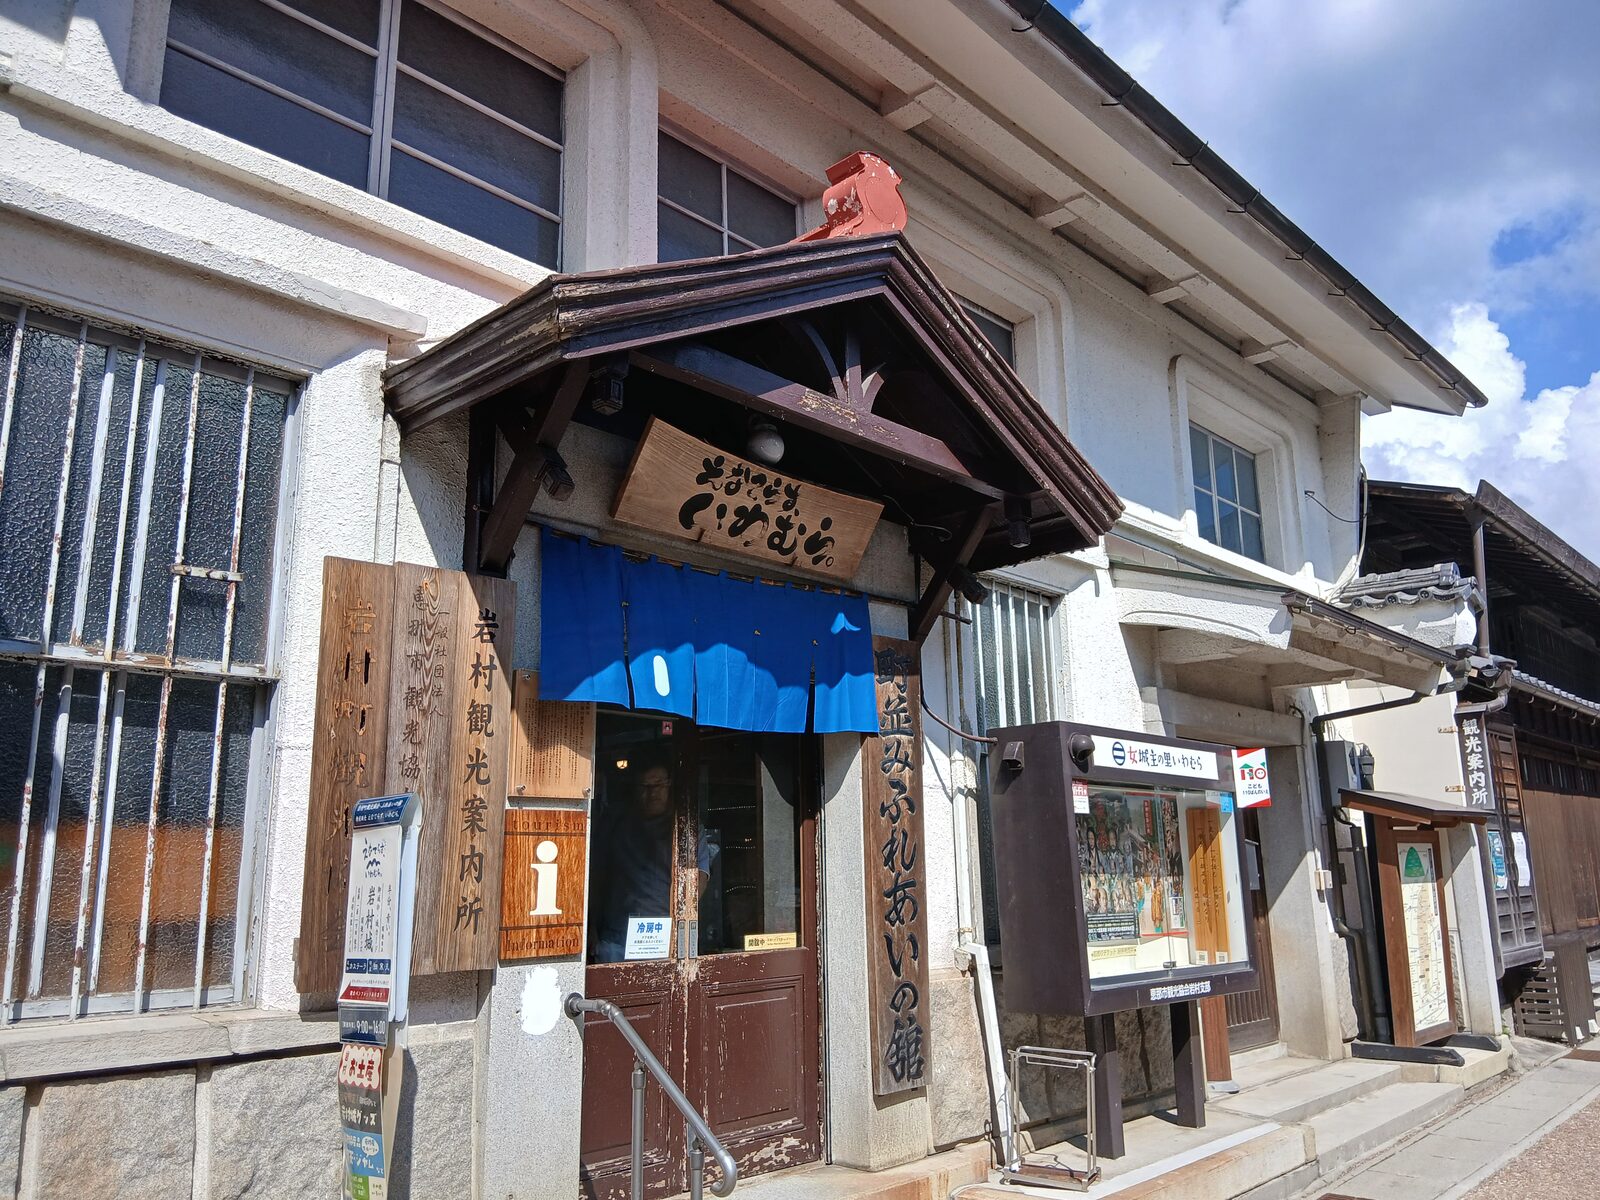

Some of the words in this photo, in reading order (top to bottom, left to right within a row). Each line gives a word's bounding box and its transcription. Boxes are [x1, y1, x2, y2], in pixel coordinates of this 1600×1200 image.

[430, 611, 450, 717] 一般社団法人
[454, 607, 499, 935] 岩村観光案内所
[1127, 745, 1203, 770] 女城主の里いわむら
[1462, 719, 1488, 805] 観光案内所
[513, 818, 586, 832] tourism
[874, 647, 925, 1083] 町並みふれあいの館
[506, 931, 580, 951] Information
[637, 922, 663, 934] 冷房中
